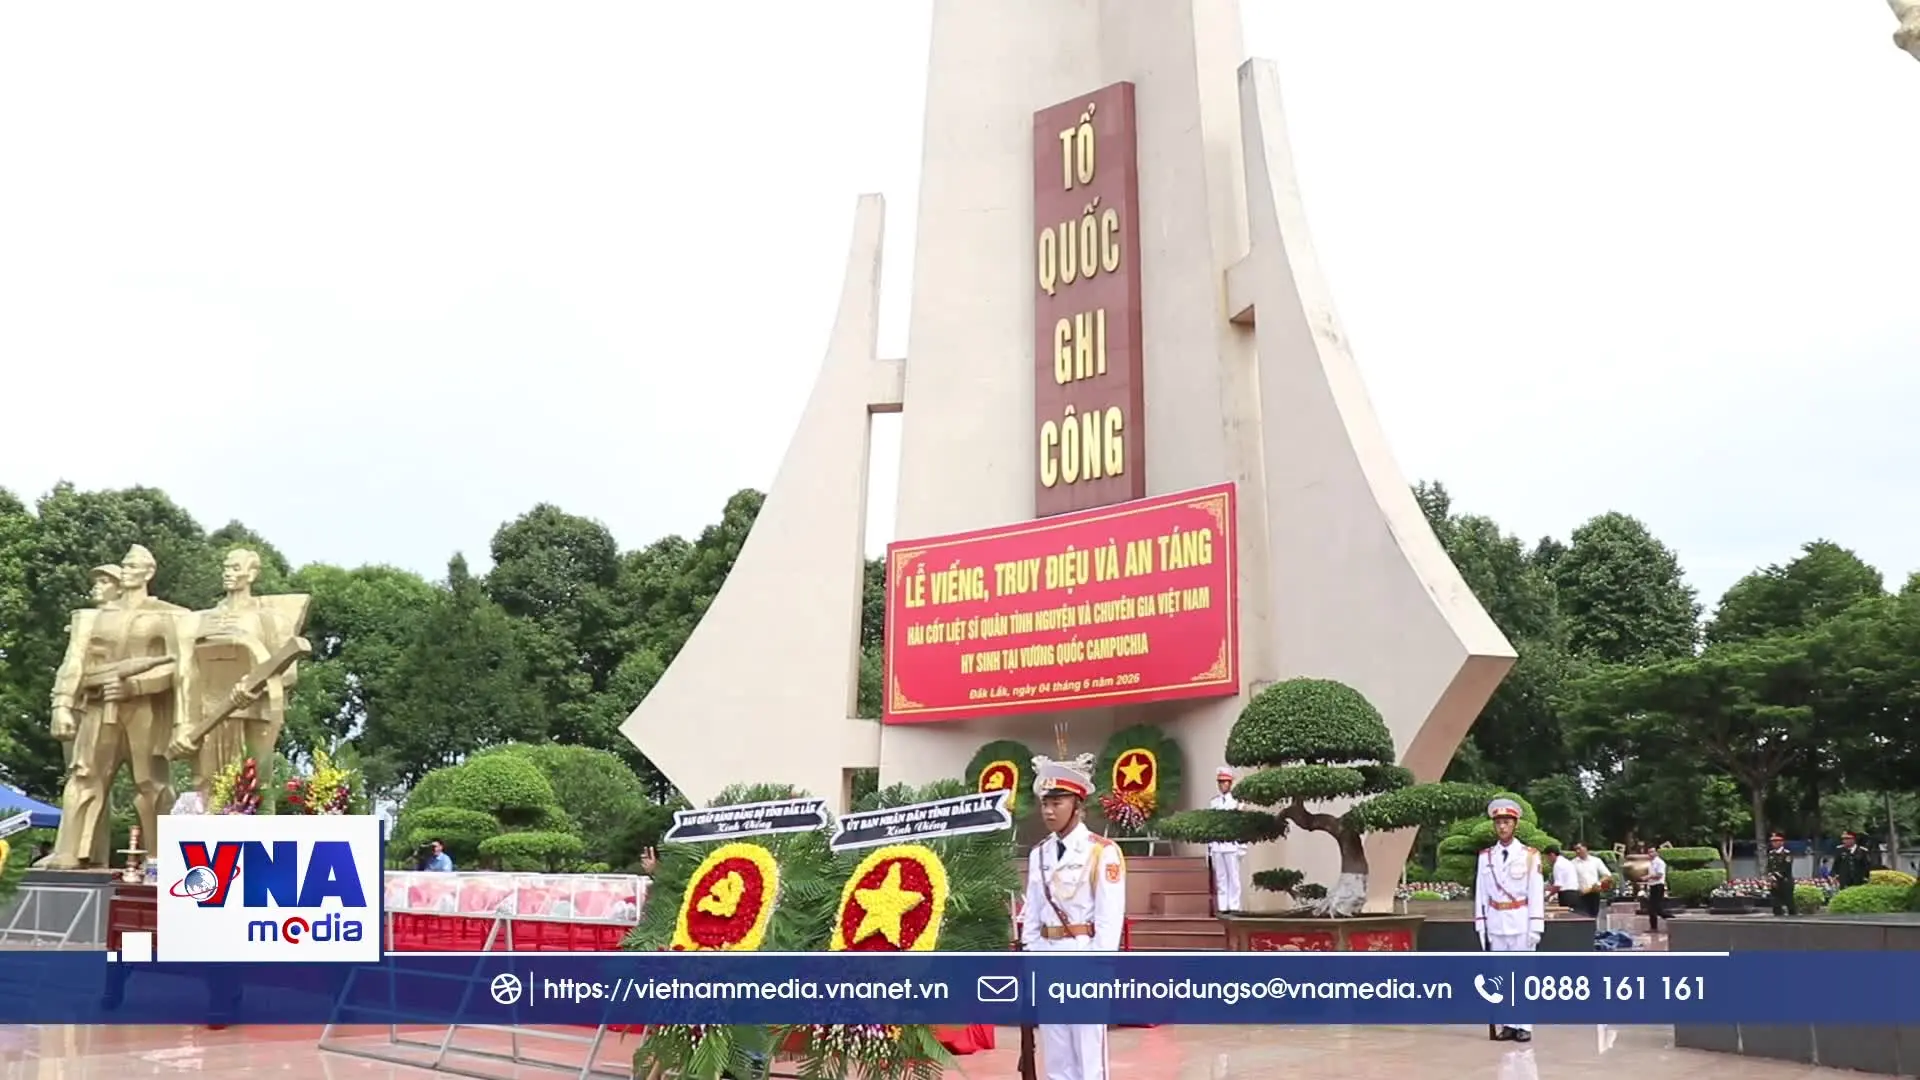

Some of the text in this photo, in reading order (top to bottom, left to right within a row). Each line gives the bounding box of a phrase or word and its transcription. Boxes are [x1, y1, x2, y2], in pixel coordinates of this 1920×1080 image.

[1059, 102, 1096, 191] TỔ
[1038, 196, 1120, 296] QUỐC
[1054, 308, 1106, 385] GHI
[1040, 404, 1124, 488] CÔNG
[905, 525, 1213, 608] LỄ VIẾNG, TRUY ĐIỆU VÀ AN TÁNG
[907, 622, 924, 646] HÀI
[926, 617, 945, 643] CỐT
[946, 617, 967, 645] LIỆT
[980, 612, 1008, 640] QUÂN
[1010, 610, 1033, 634] TÌNH
[1035, 603, 1076, 632] NGUYỆN
[1077, 600, 1092, 625] VÀ
[1093, 595, 1135, 624] CHUYÊN
[1137, 595, 1156, 618] GIA
[1157, 587, 1181, 618] VIỆT
[1183, 586, 1210, 611] NAM
[961, 654, 976, 674] HY
[976, 651, 1001, 673] SINH
[1002, 649, 1019, 674] TẠI
[1056, 634, 1085, 666] QUỐC
[1086, 632, 1149, 661] CAMPUCHIA
[1012, 683, 1037, 698] ngày
[1038, 683, 1050, 693] 04
[1052, 680, 1081, 693] tháng
[1092, 677, 1114, 688] năm
[683, 816, 697, 827] BAN
[860, 817, 879, 829] BAN
[880, 813, 905, 827] NHÂN
[906, 809, 926, 822] DÂN
